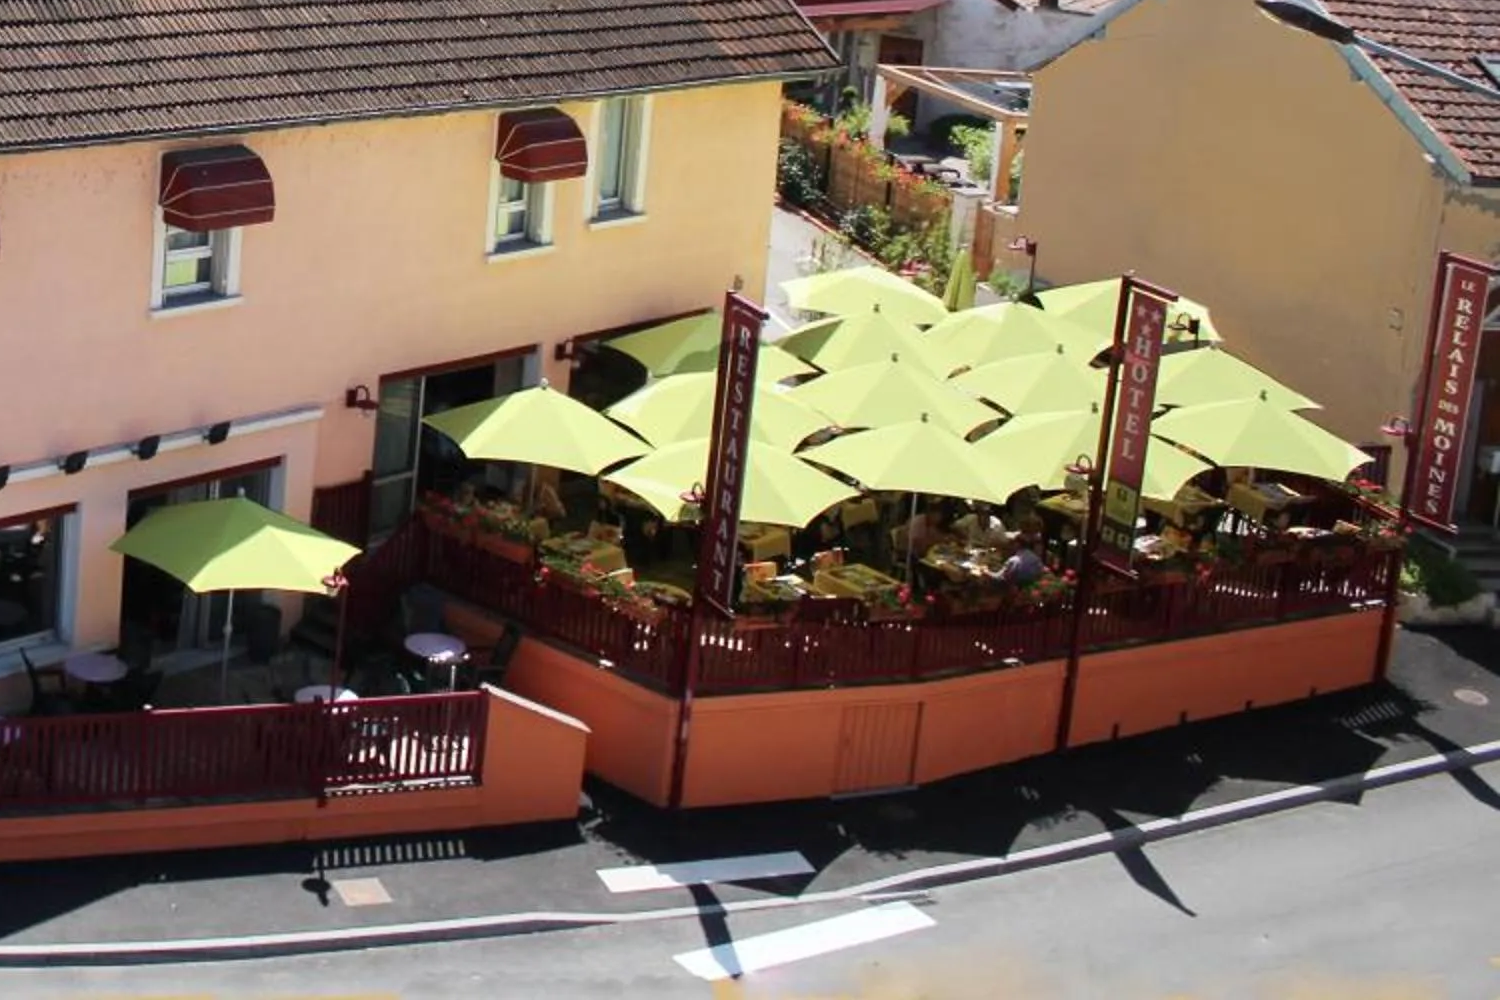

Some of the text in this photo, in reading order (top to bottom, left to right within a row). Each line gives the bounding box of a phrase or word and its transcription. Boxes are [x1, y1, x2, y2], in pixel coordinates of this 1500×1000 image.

[712, 326, 751, 592] RESTAURANT
[1121, 335, 1152, 461] HOTEL
[1426, 279, 1477, 513] LE RELAIS DES MOINES
